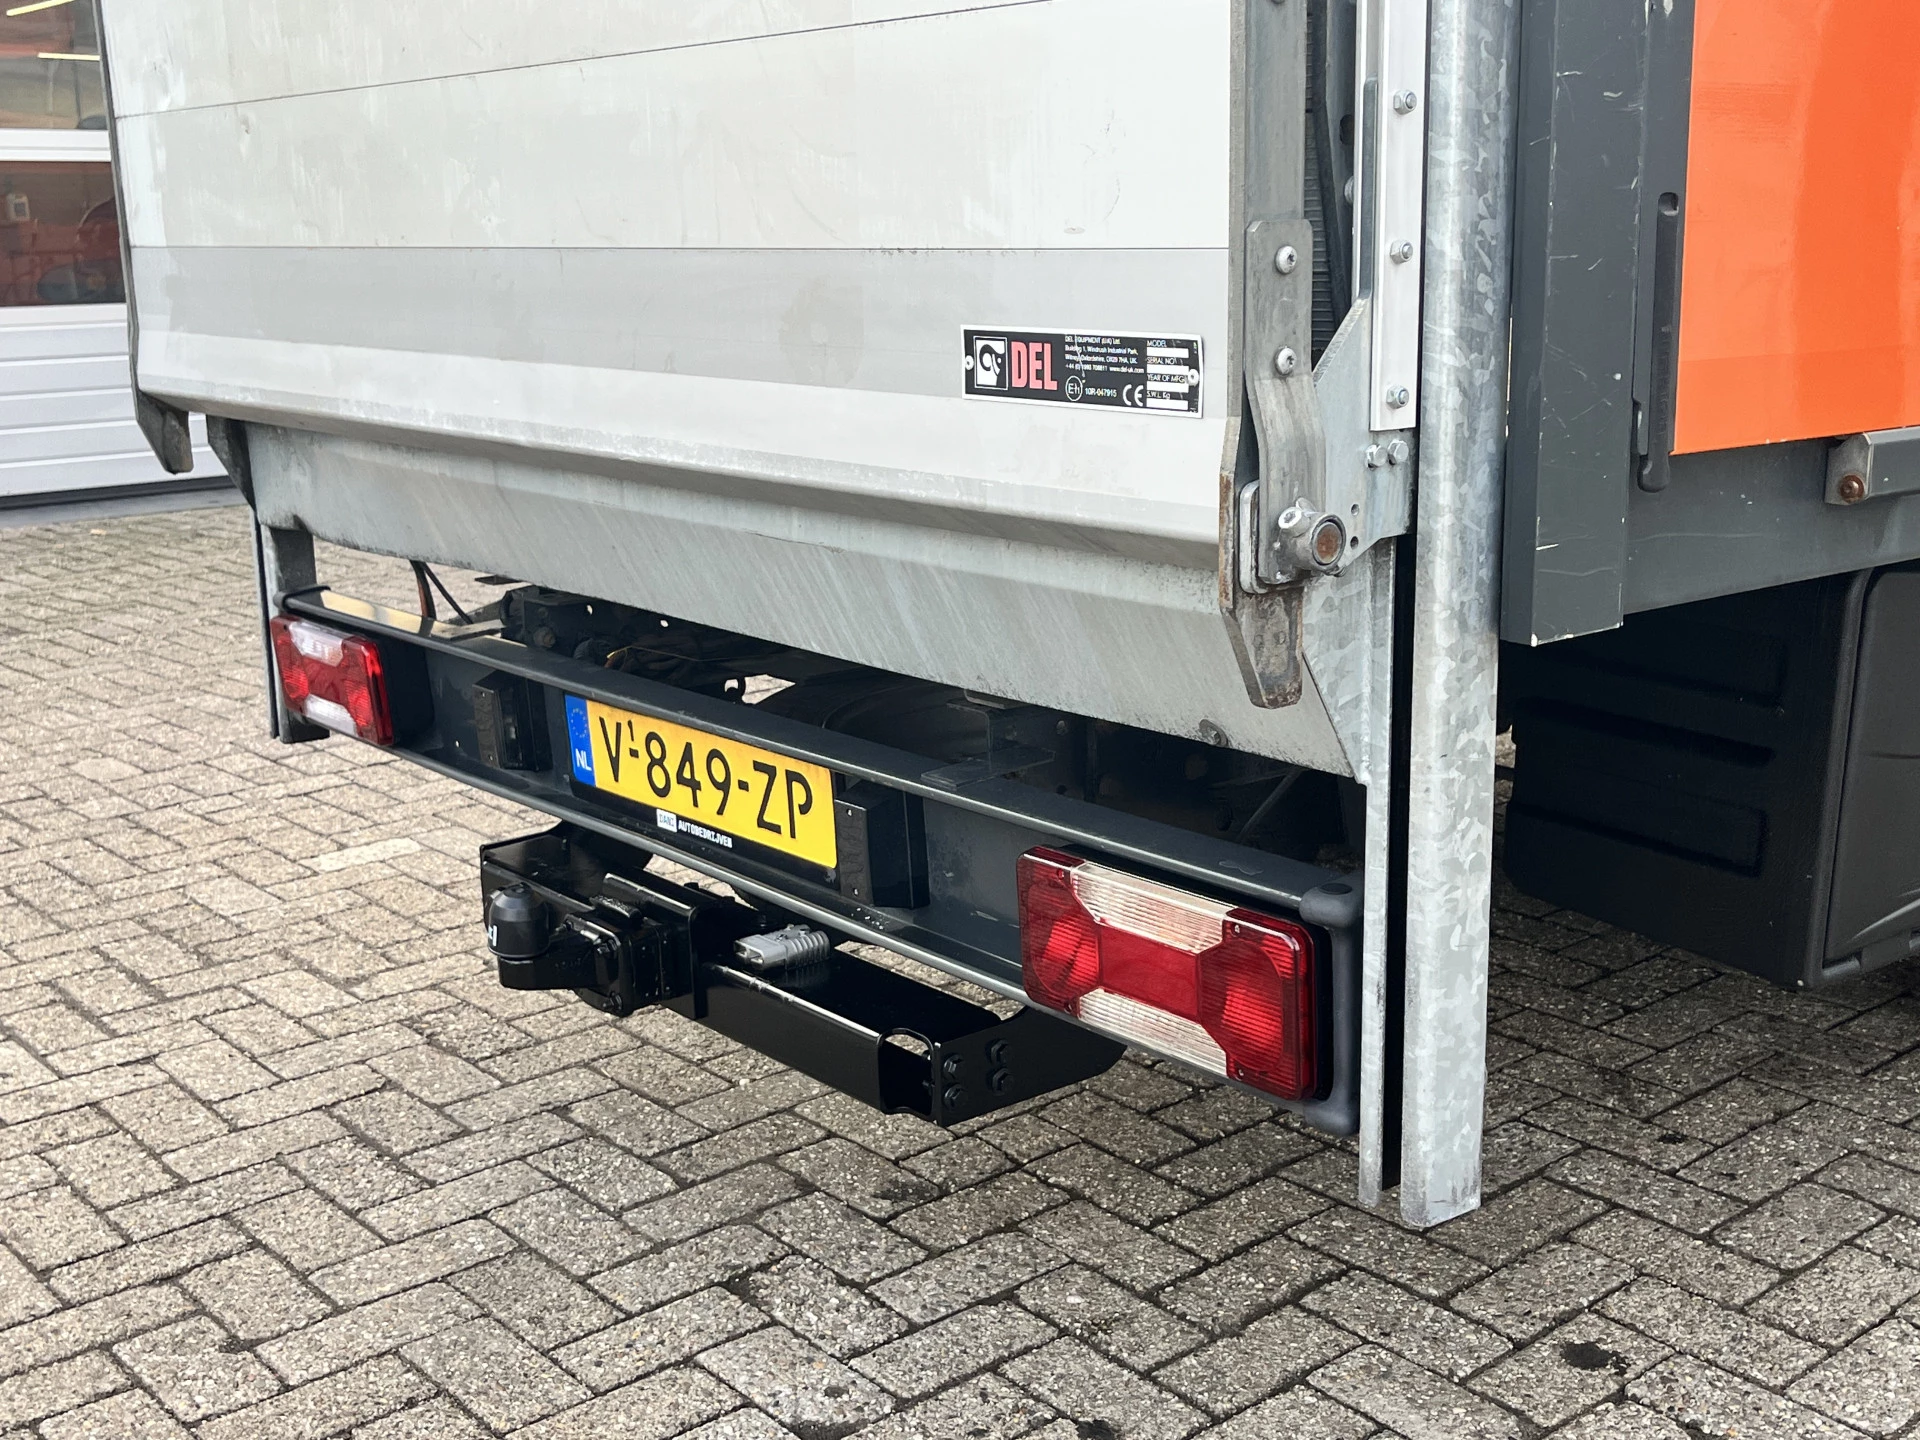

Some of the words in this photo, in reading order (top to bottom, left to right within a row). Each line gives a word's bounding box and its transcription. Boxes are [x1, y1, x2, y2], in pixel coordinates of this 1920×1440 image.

[1011, 341, 1058, 390] DEL
[1085, 388, 1117, 398] 10R-047915
[1123, 384, 1144, 406] CE
[575, 748, 592, 771] NL
[678, 820, 733, 848] AUTOBEDRIJVEN
